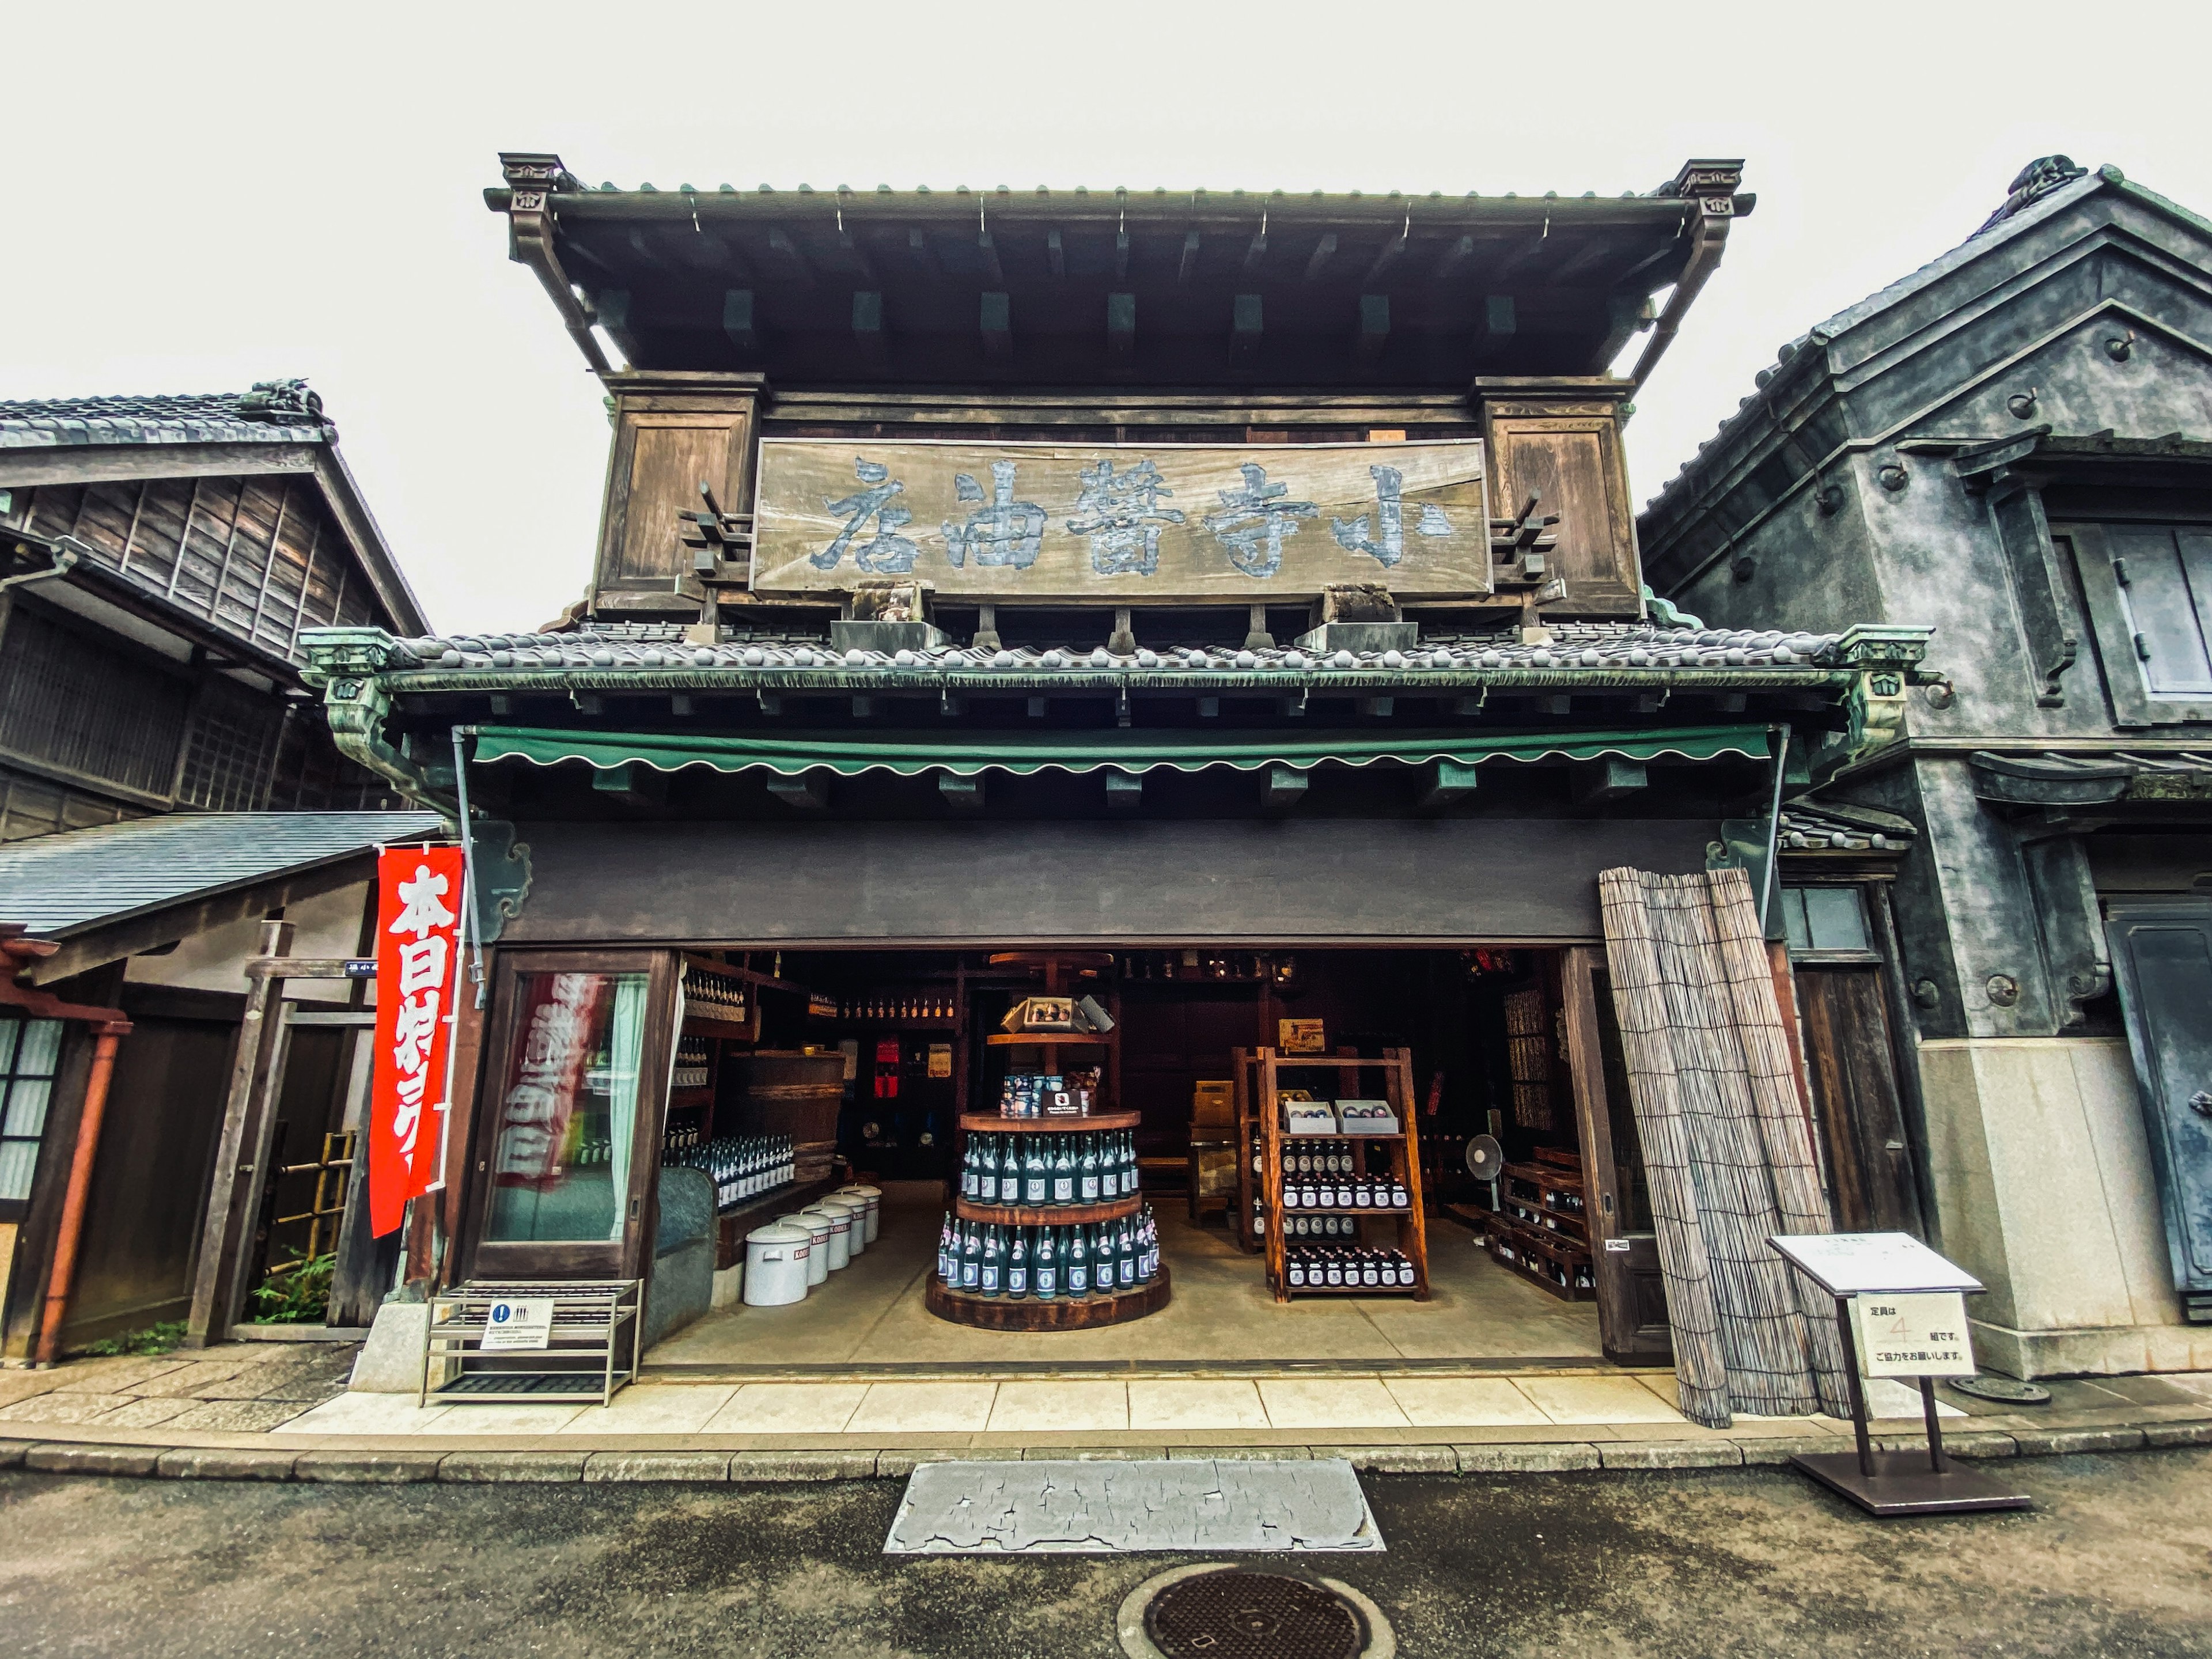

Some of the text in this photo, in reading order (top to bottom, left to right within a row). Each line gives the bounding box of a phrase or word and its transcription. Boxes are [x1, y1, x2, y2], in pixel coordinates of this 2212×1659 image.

[1870, 1306, 1896, 1316] 定員は
[1890, 1317, 1911, 1343] 4
[1876, 1351, 1963, 1361] ご協力をお願いします。
